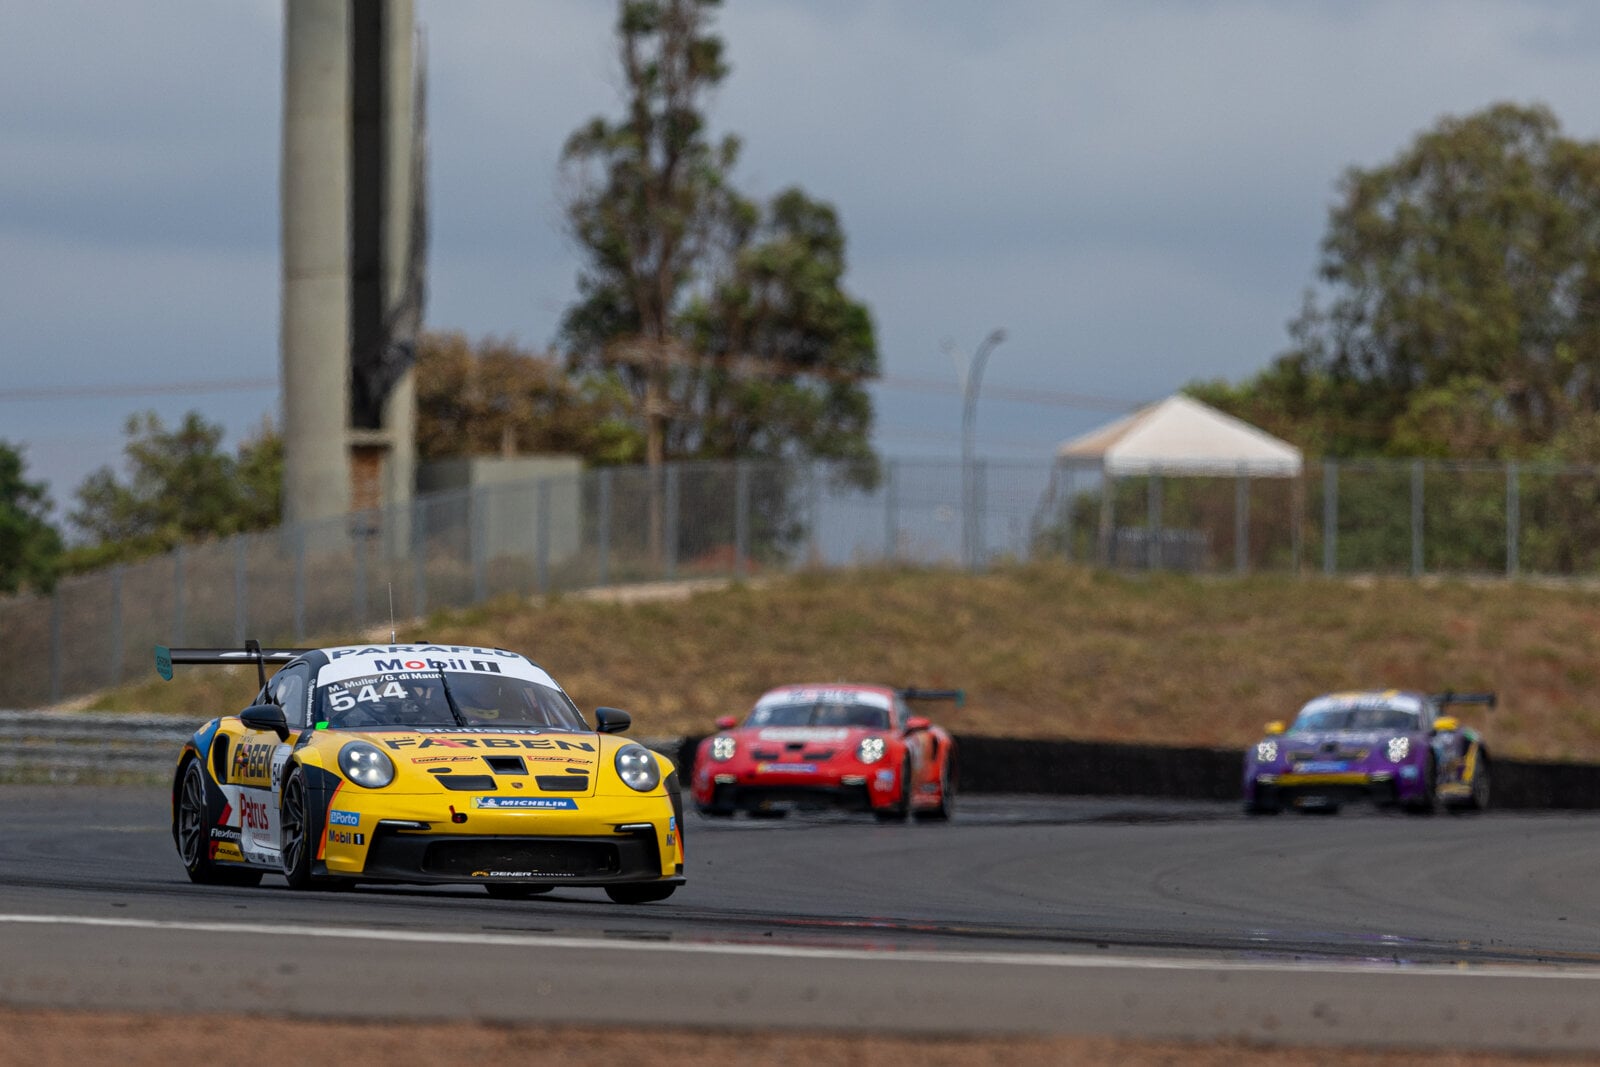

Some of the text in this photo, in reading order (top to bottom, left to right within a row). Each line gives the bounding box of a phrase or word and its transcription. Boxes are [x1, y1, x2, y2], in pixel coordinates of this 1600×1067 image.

[374, 658, 467, 672] Mobil
[328, 684, 343, 693] M.
[329, 681, 408, 712] 544
[384, 739, 596, 752] FARBEN
[240, 792, 269, 830] Patrus
[336, 812, 358, 825] Porto
[210, 828, 242, 839] Flexform
[329, 830, 352, 845] Mobil
